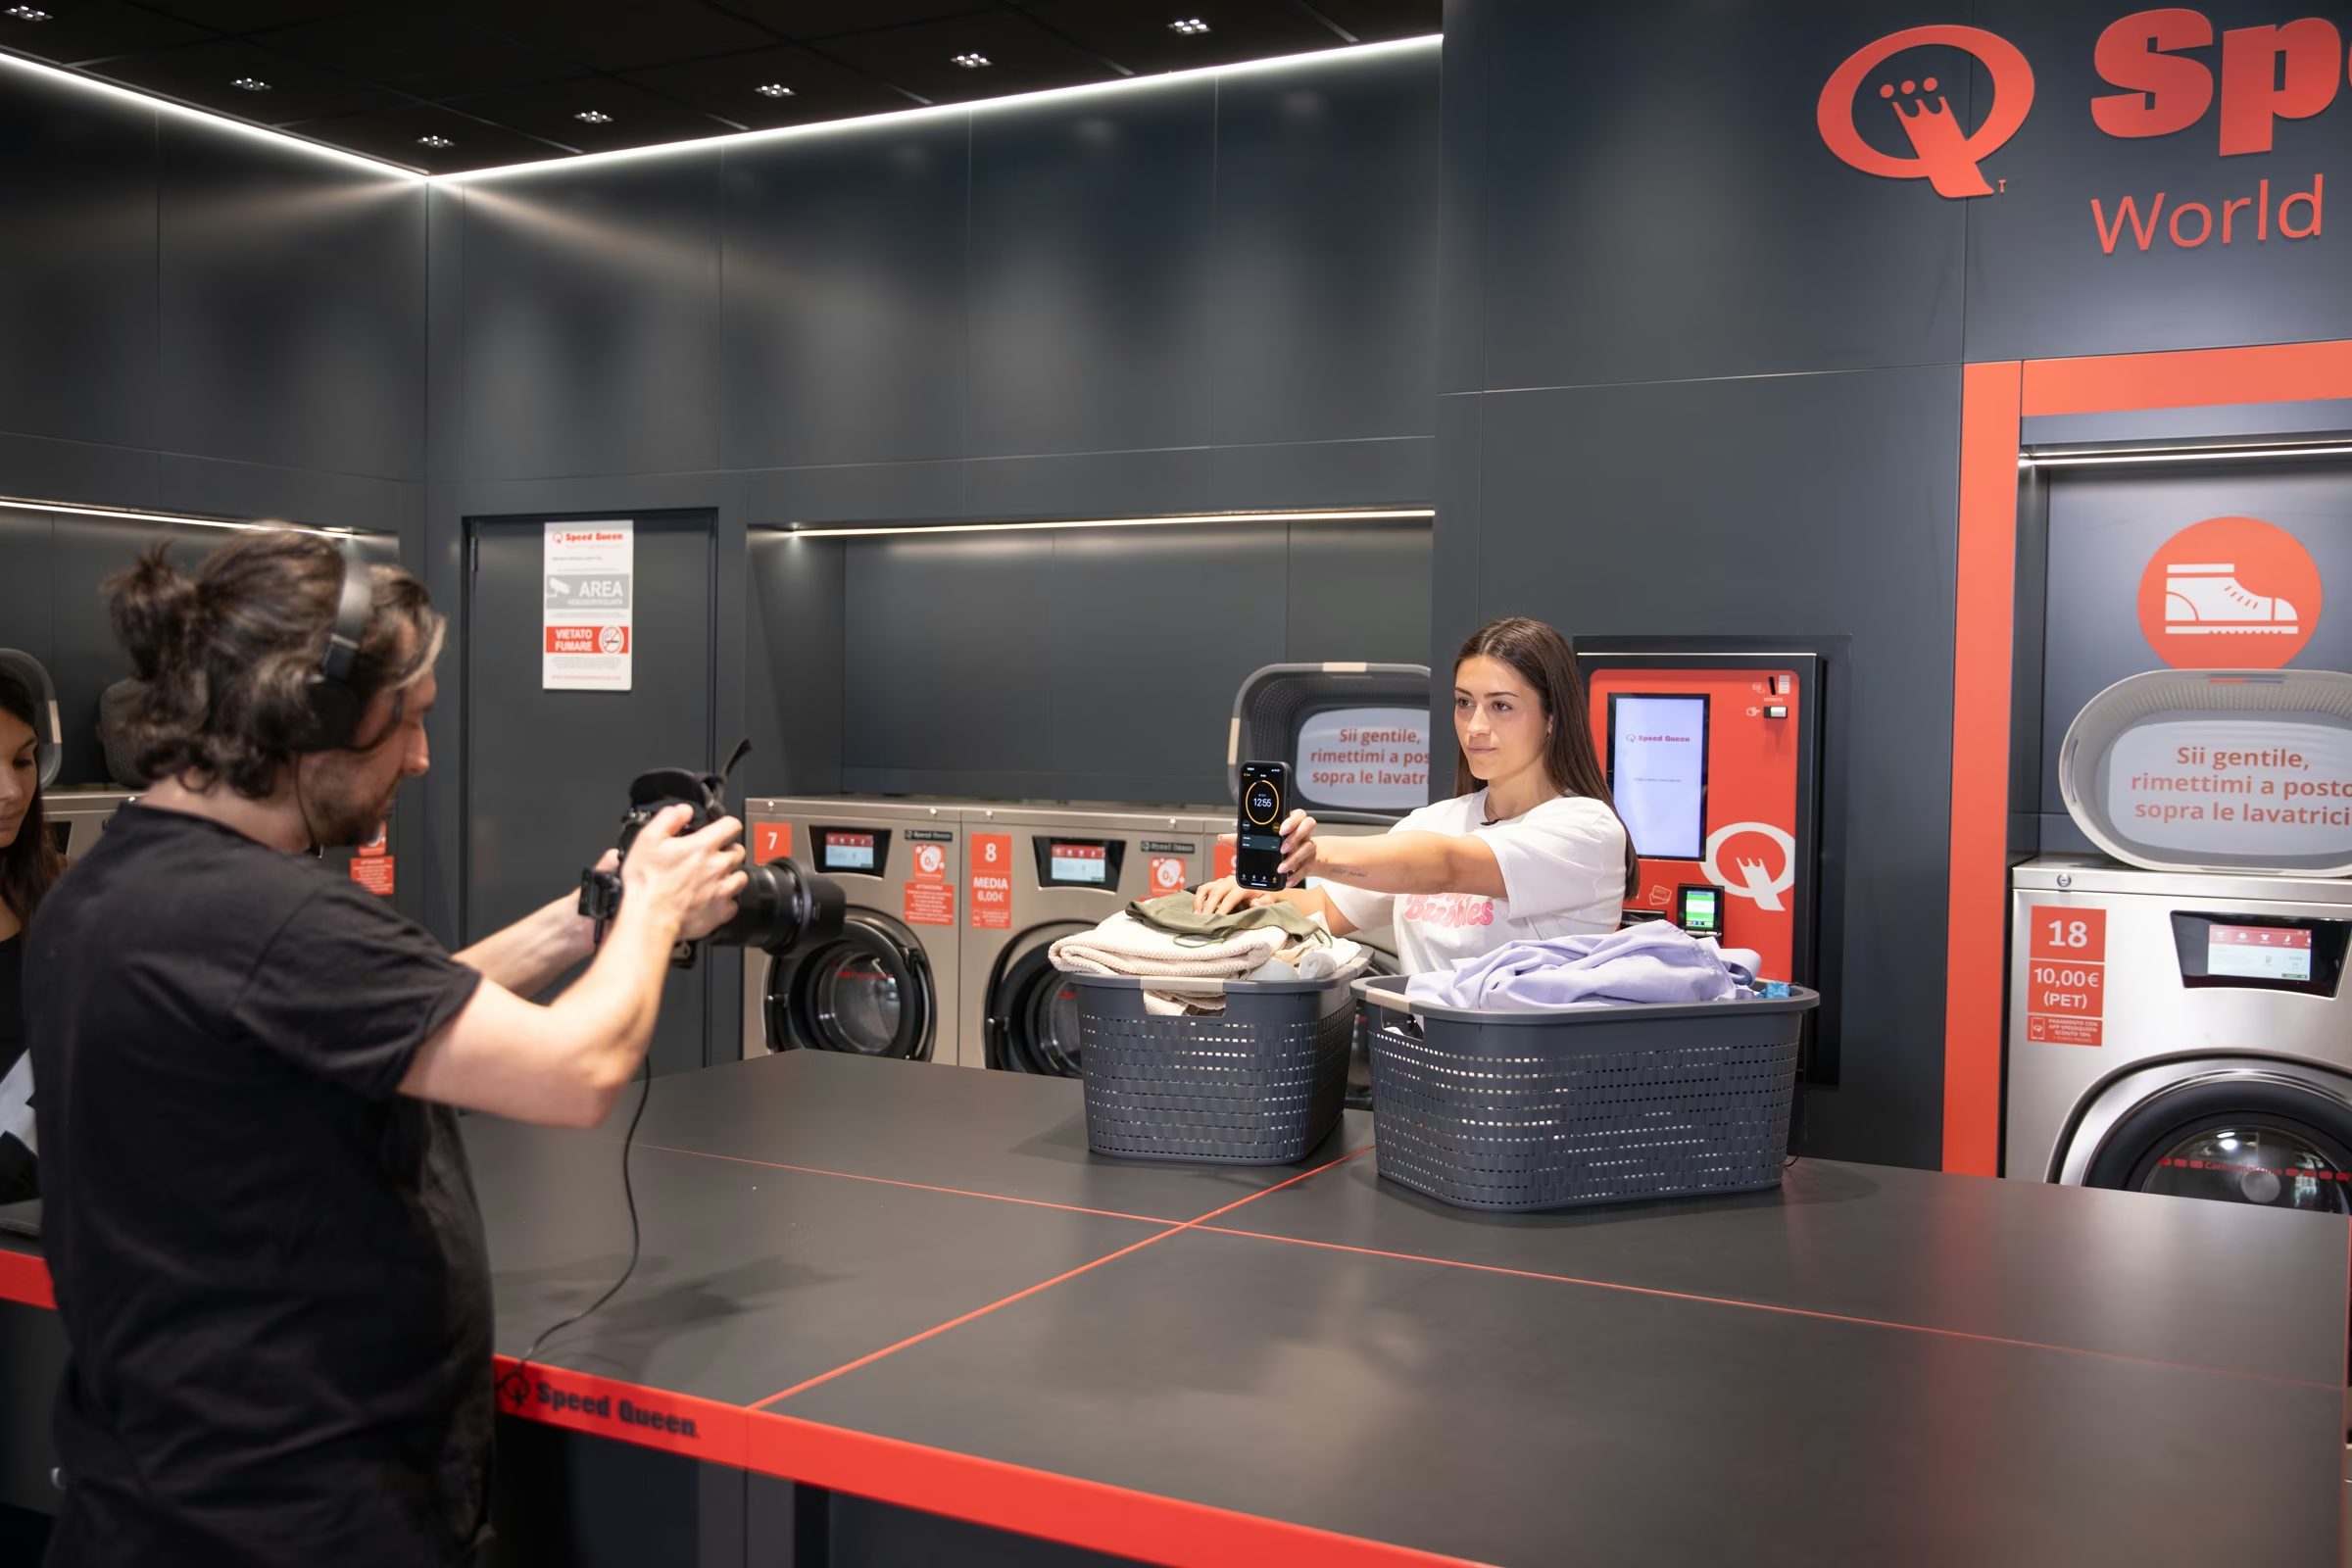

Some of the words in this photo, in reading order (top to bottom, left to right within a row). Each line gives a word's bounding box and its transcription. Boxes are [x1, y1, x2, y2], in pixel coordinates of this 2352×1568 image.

[2090, 8, 2352, 157] Sp
[2090, 173, 2324, 255] World
[565, 532, 593, 542] Speed
[596, 532, 622, 541] Queen
[578, 580, 624, 598] AREA
[555, 628, 593, 640] VIETATO
[555, 641, 593, 652] FUMARE
[1339, 728, 1357, 743] Sii
[1361, 728, 1421, 746] gentile,
[1310, 749, 1385, 763] rimettimi
[1389, 752, 1399, 763] a
[2177, 746, 2205, 765] Sii
[2213, 748, 2310, 770] gentile,
[1312, 772, 1355, 787] sopra
[1360, 769, 1373, 784] le
[2132, 772, 2252, 795] rimettimi
[2260, 780, 2275, 795] a
[2134, 801, 2204, 823] sopra
[2213, 802, 2234, 821] le
[2243, 803, 2350, 826] lavatrici
[767, 832, 778, 851] 7
[985, 842, 998, 862] 8
[973, 876, 1008, 890] MEDIA
[977, 891, 1004, 903] 6,00€
[2048, 919, 2087, 949] 18
[2034, 967, 2099, 988] 10,00€
[2043, 991, 2088, 1009] (PET)
[536, 1382, 611, 1418] Speed
[617, 1398, 698, 1438] Queen
